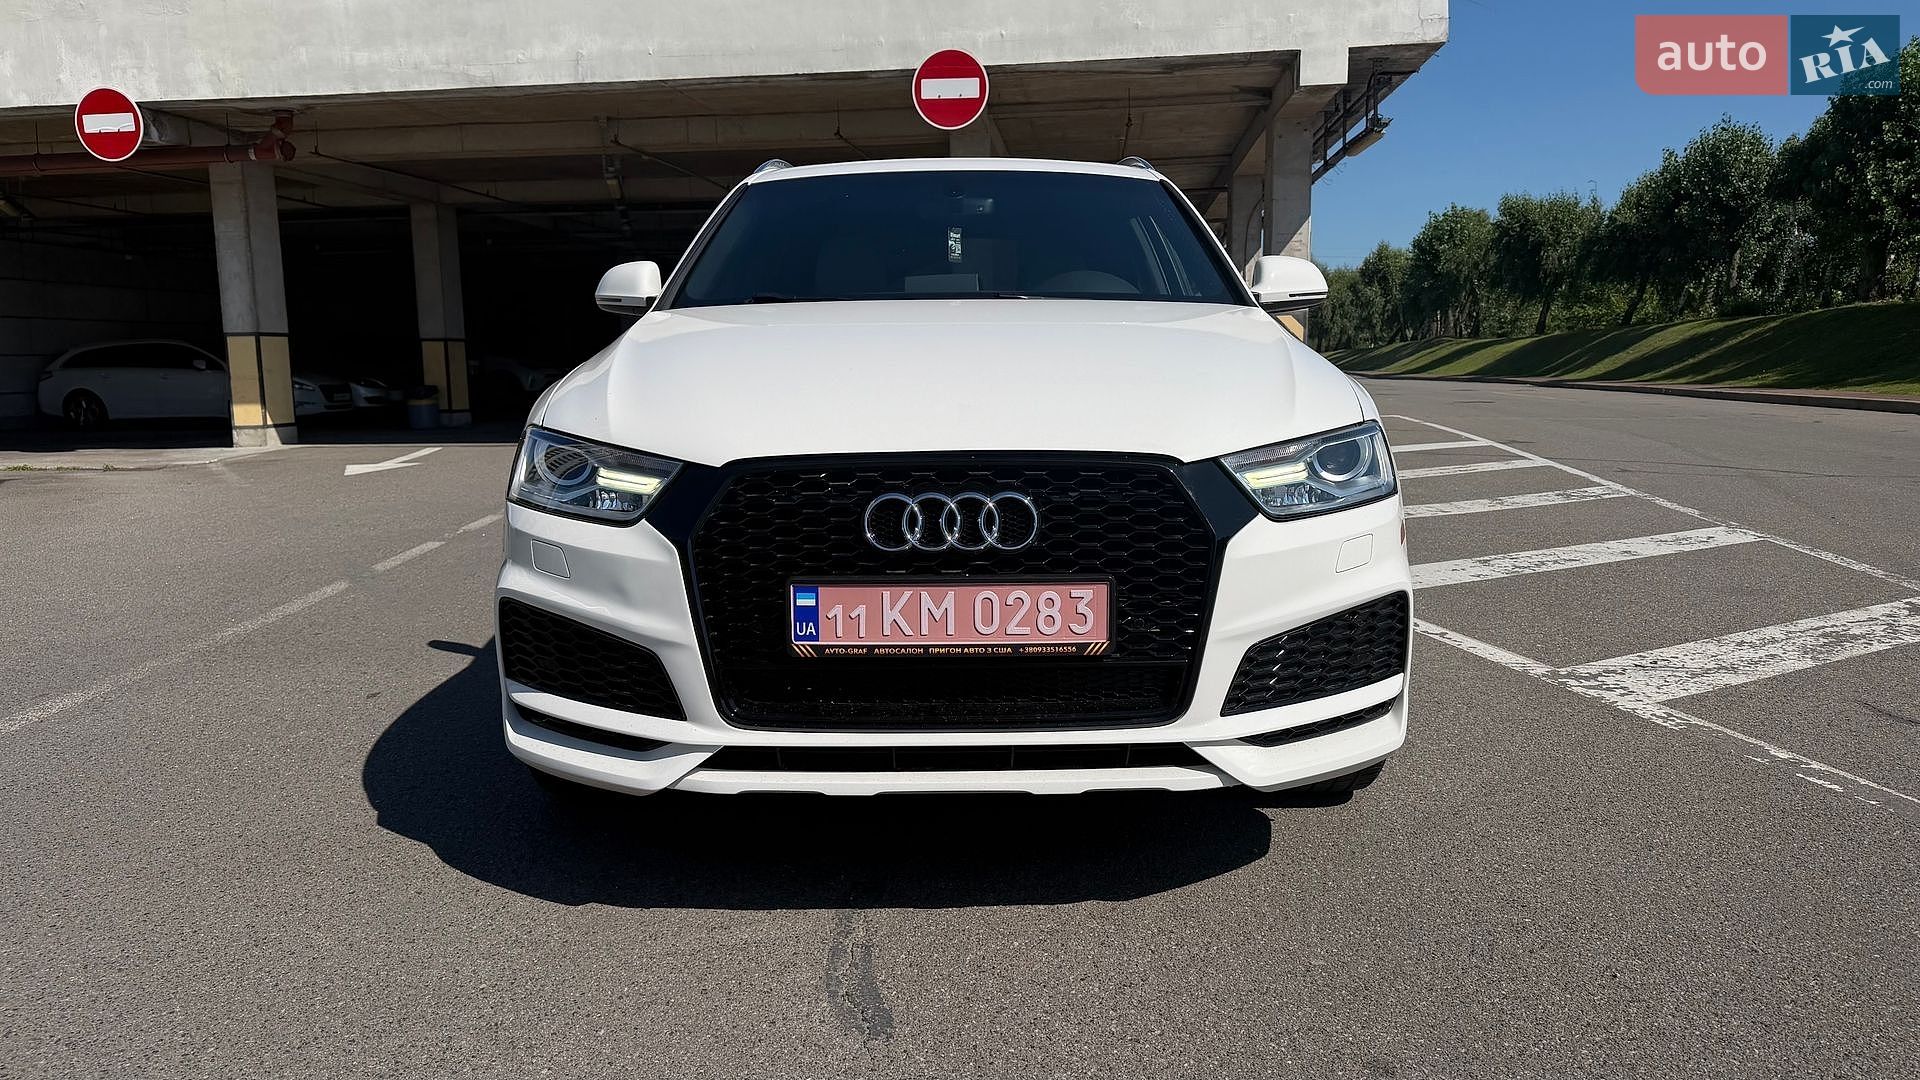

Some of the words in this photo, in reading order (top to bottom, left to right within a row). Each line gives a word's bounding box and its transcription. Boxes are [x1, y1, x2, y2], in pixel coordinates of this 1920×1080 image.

[825, 604, 866, 638] 11
[881, 591, 955, 636] KM
[973, 589, 1094, 636] 0283
[796, 621, 817, 636] UA
[1019, 646, 1077, 654] +380933516556
